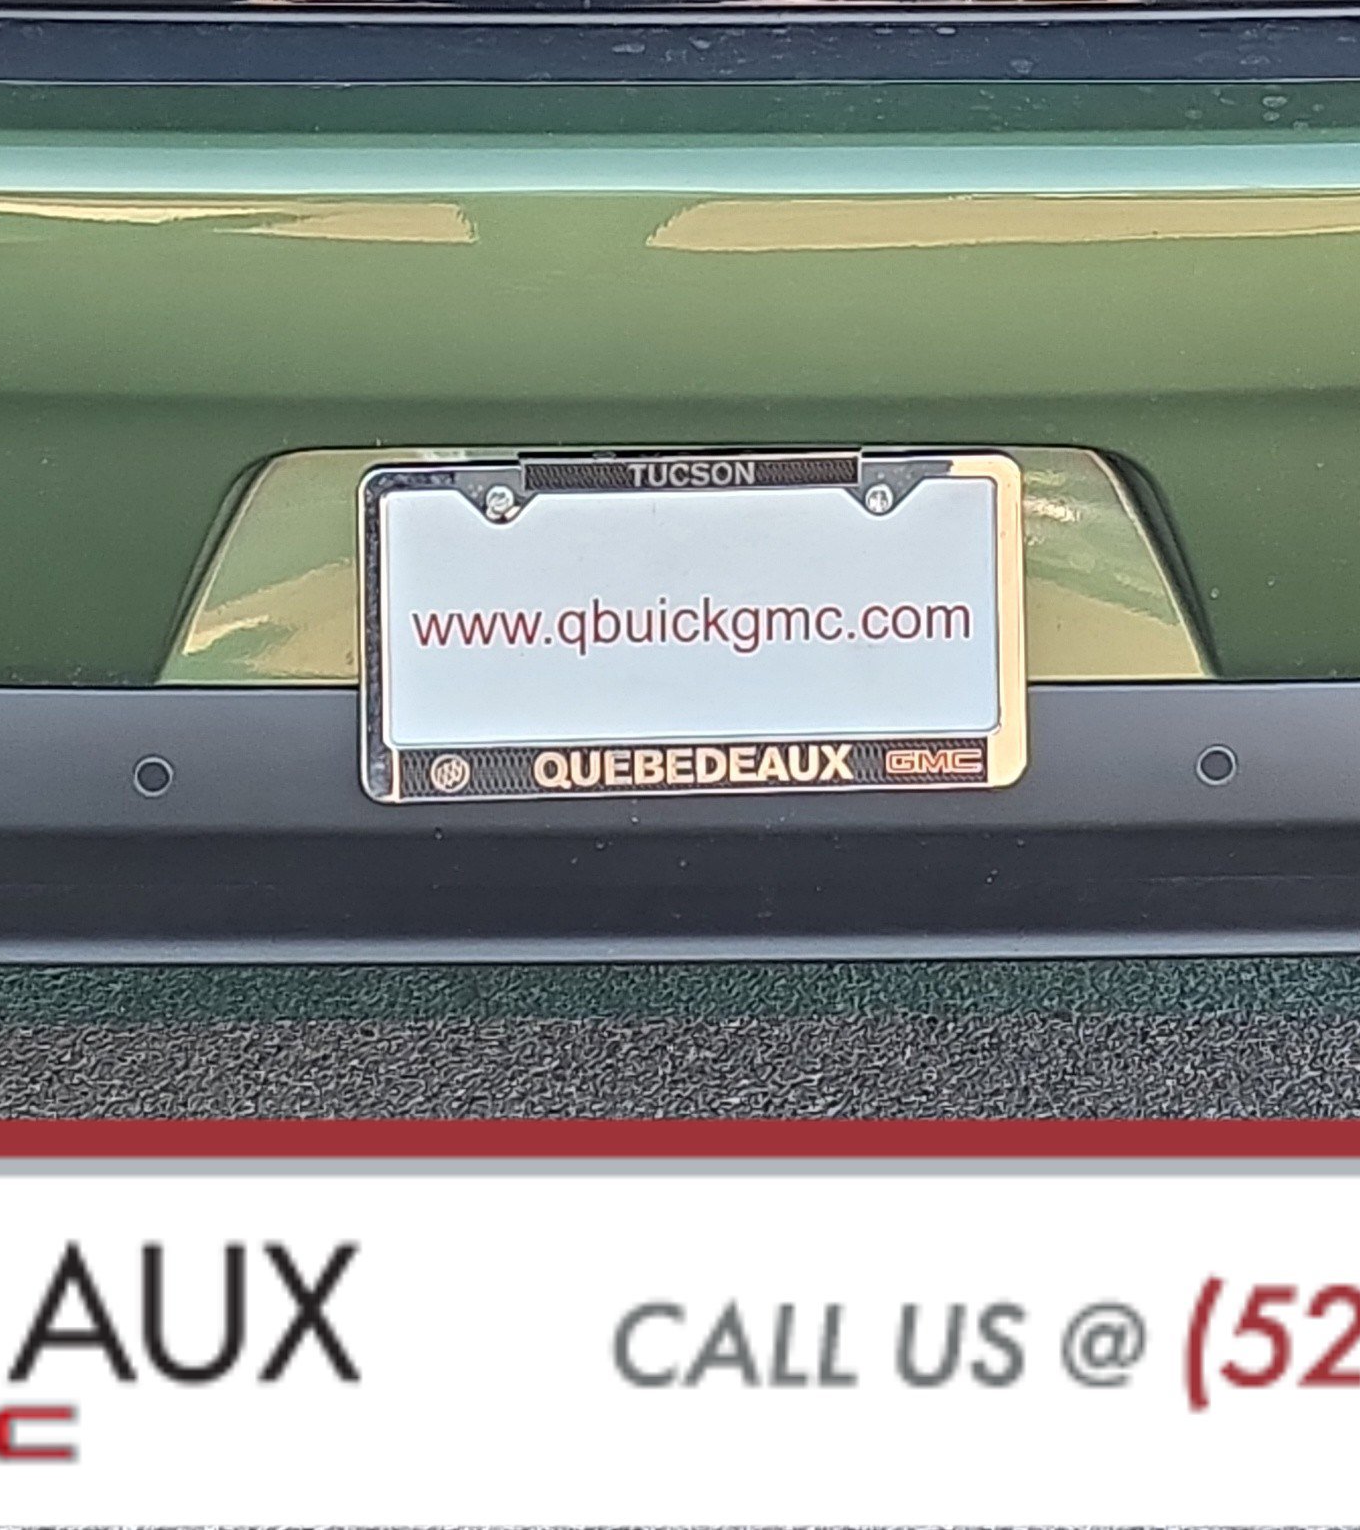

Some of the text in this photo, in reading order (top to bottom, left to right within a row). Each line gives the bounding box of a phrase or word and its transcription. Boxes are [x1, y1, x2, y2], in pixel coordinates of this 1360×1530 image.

[628, 461, 756, 487] TUCSON
[411, 596, 971, 656] www.qbuickgmc.com
[533, 745, 982, 789] QUEBEDEAUX GMC
